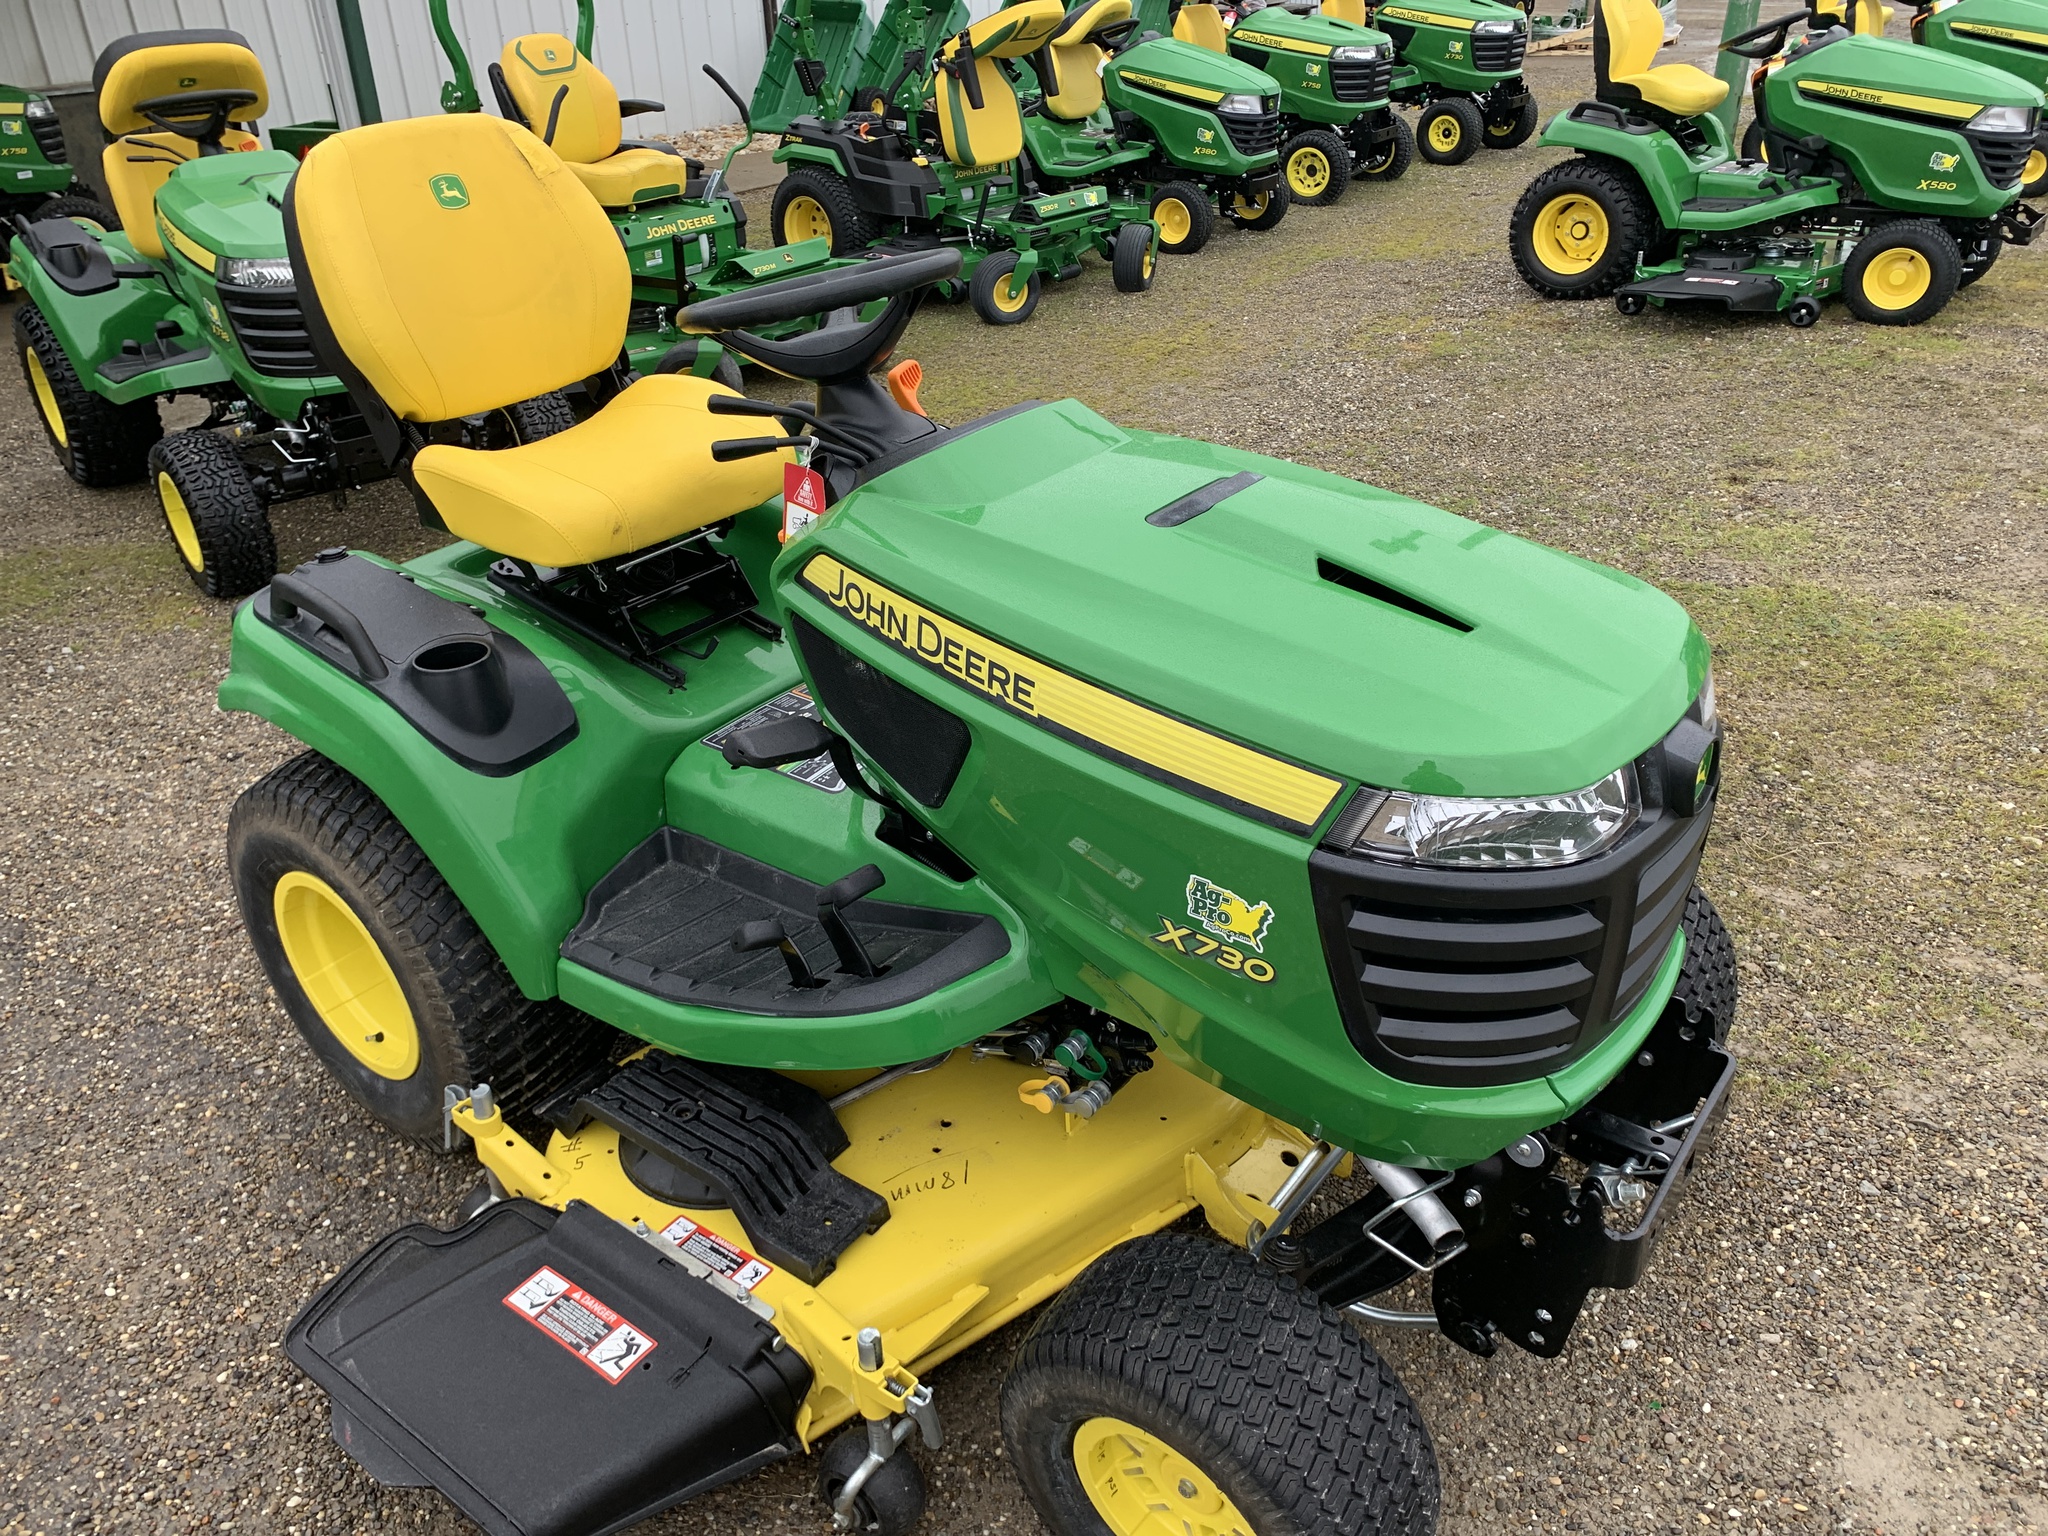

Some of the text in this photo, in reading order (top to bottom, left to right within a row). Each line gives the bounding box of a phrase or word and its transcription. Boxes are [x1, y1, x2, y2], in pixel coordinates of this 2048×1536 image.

[1388, 8, 1429, 22] JOHN DEERE
[1240, 31, 1283, 47] JOHN DEERE
[1970, 25, 2014, 38] JOHN DEERE
[1132, 74, 1167, 89] JOHN DEERE
[1823, 84, 1883, 103] JOHN DEERE
[1193, 146, 1217, 156] X380
[954, 164, 998, 179] JOHN DEERE
[1916, 180, 1957, 191] X580
[646, 214, 718, 240] JOHN DEERE
[829, 568, 1036, 711] JOHN DEERE
[1191, 897, 1232, 925] Pro
[1154, 917, 1275, 983] X730
[573, 1152, 592, 1170] 5
[715, 1235, 741, 1254] DANGER
[580, 1295, 618, 1323] DANGER
